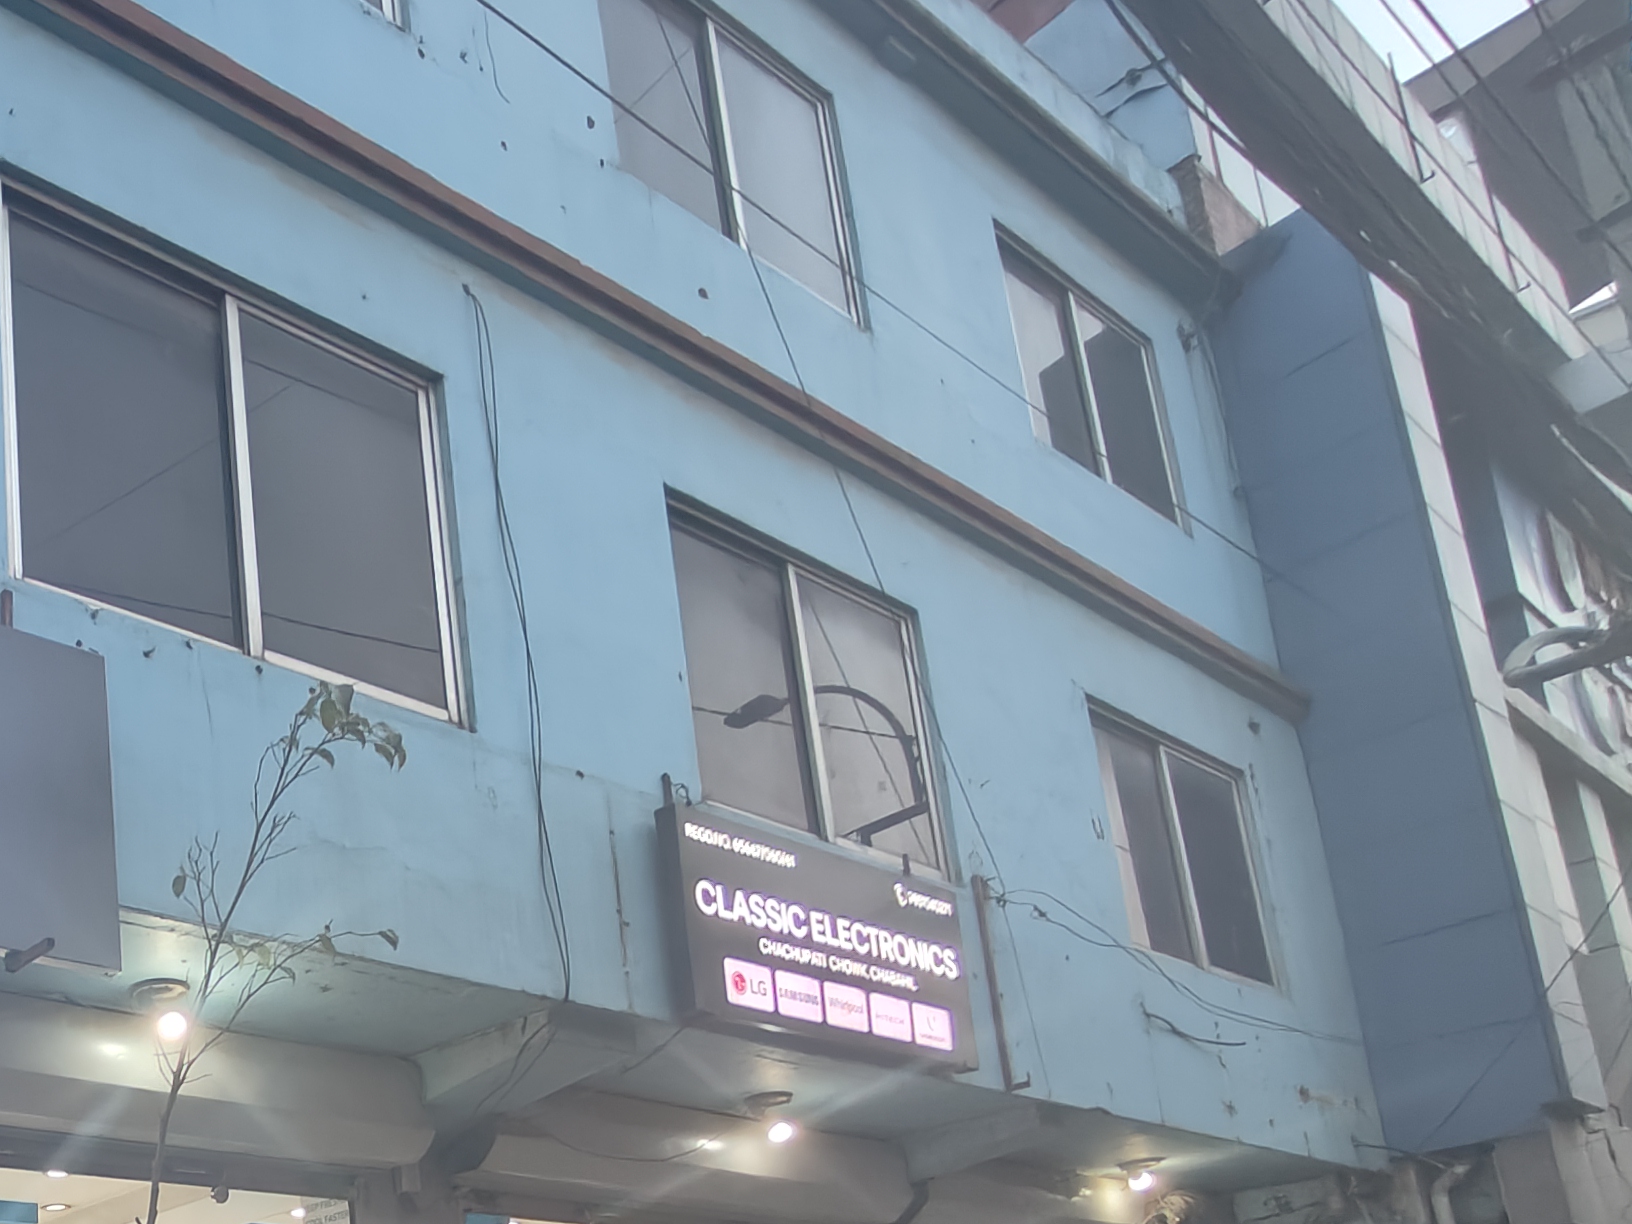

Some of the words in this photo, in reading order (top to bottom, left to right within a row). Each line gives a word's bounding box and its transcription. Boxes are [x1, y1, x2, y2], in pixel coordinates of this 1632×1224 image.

[694, 879, 808, 939] CLASSIC
[809, 911, 961, 980] ELECTRONICS
[749, 980, 767, 997] LG
